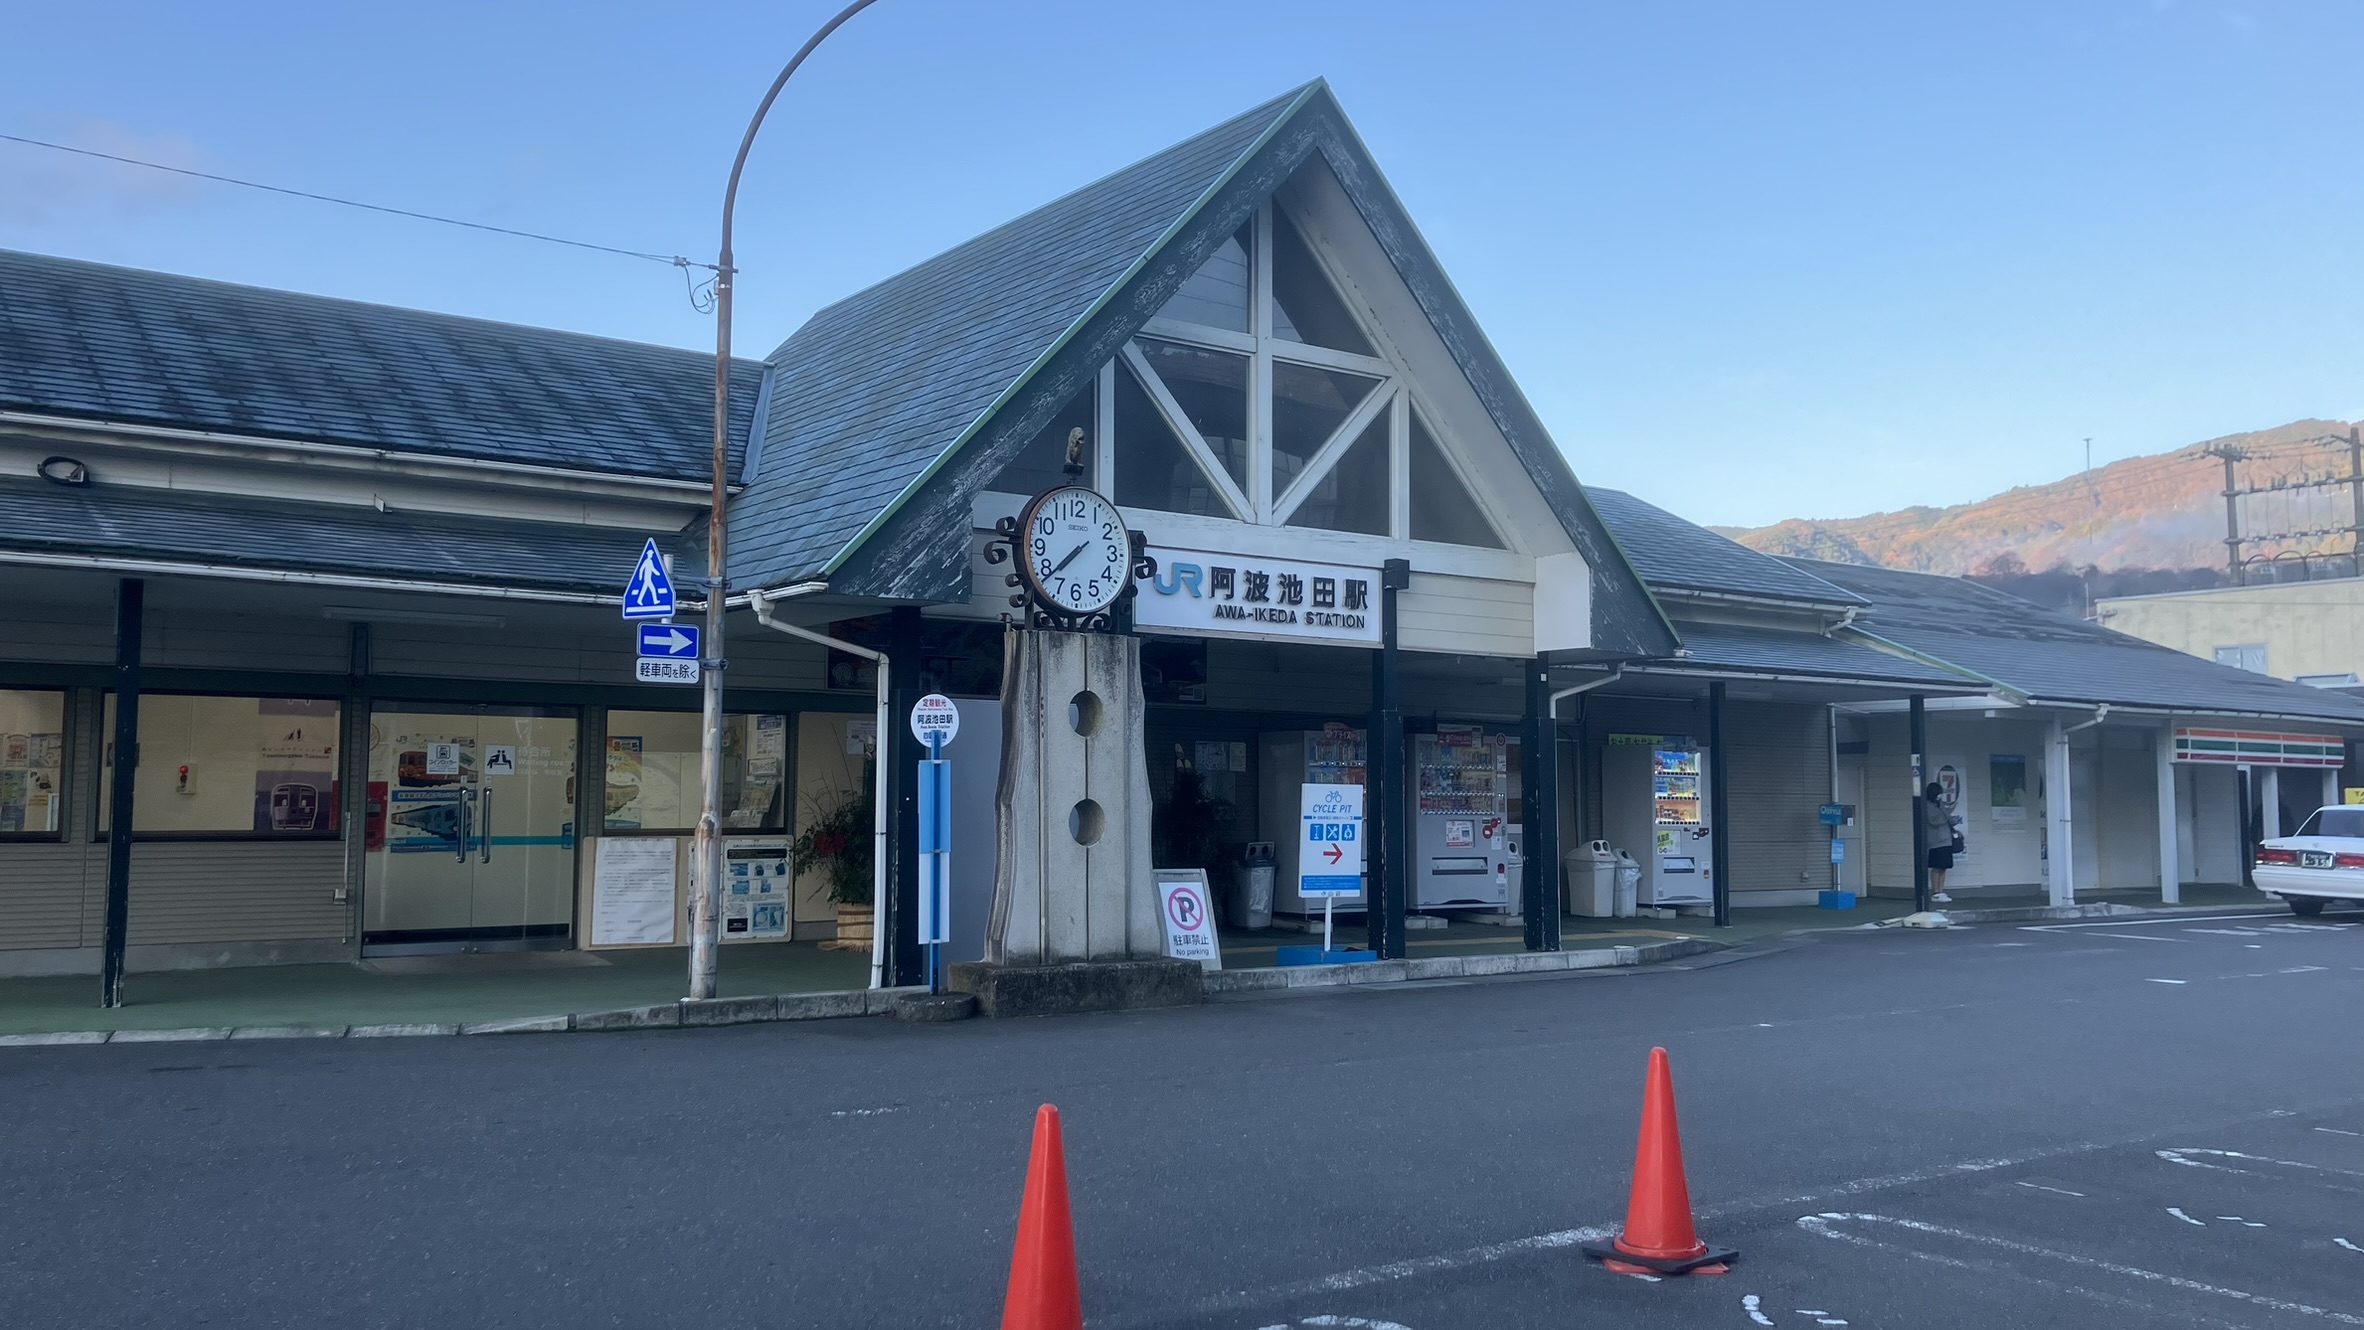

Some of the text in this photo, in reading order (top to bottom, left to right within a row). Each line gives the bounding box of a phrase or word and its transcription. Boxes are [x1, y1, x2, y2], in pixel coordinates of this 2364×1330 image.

[1055, 502, 1066, 521] 11
[1070, 499, 1086, 518] 12
[1093, 506, 1097, 524] 1
[1039, 516, 1055, 535] 10
[1068, 524, 1088, 532] SEIKO
[1102, 522, 1113, 540] 2
[1034, 538, 1046, 556] 9
[1106, 544, 1118, 562] 3
[1040, 558, 1052, 577] 8
[1101, 565, 1113, 583] 4
[1054, 577, 1066, 594] 7
[1070, 583, 1082, 601] 6
[1088, 579, 1099, 597] 5
[1153, 562, 1369, 610] JR 阿波池田駅
[1213, 604, 1366, 629] AWA-IKEDA STATION
[640, 662, 697, 679] 軽車両を除く
[923, 698, 947, 707] 定期観光
[917, 714, 954, 724] 阿波池田駅
[518, 758, 548, 767] Waiting
[1312, 804, 1353, 813] CYCLE PIT
[1173, 934, 1210, 946] 駐車禁止
[1176, 948, 1210, 957] No parking
